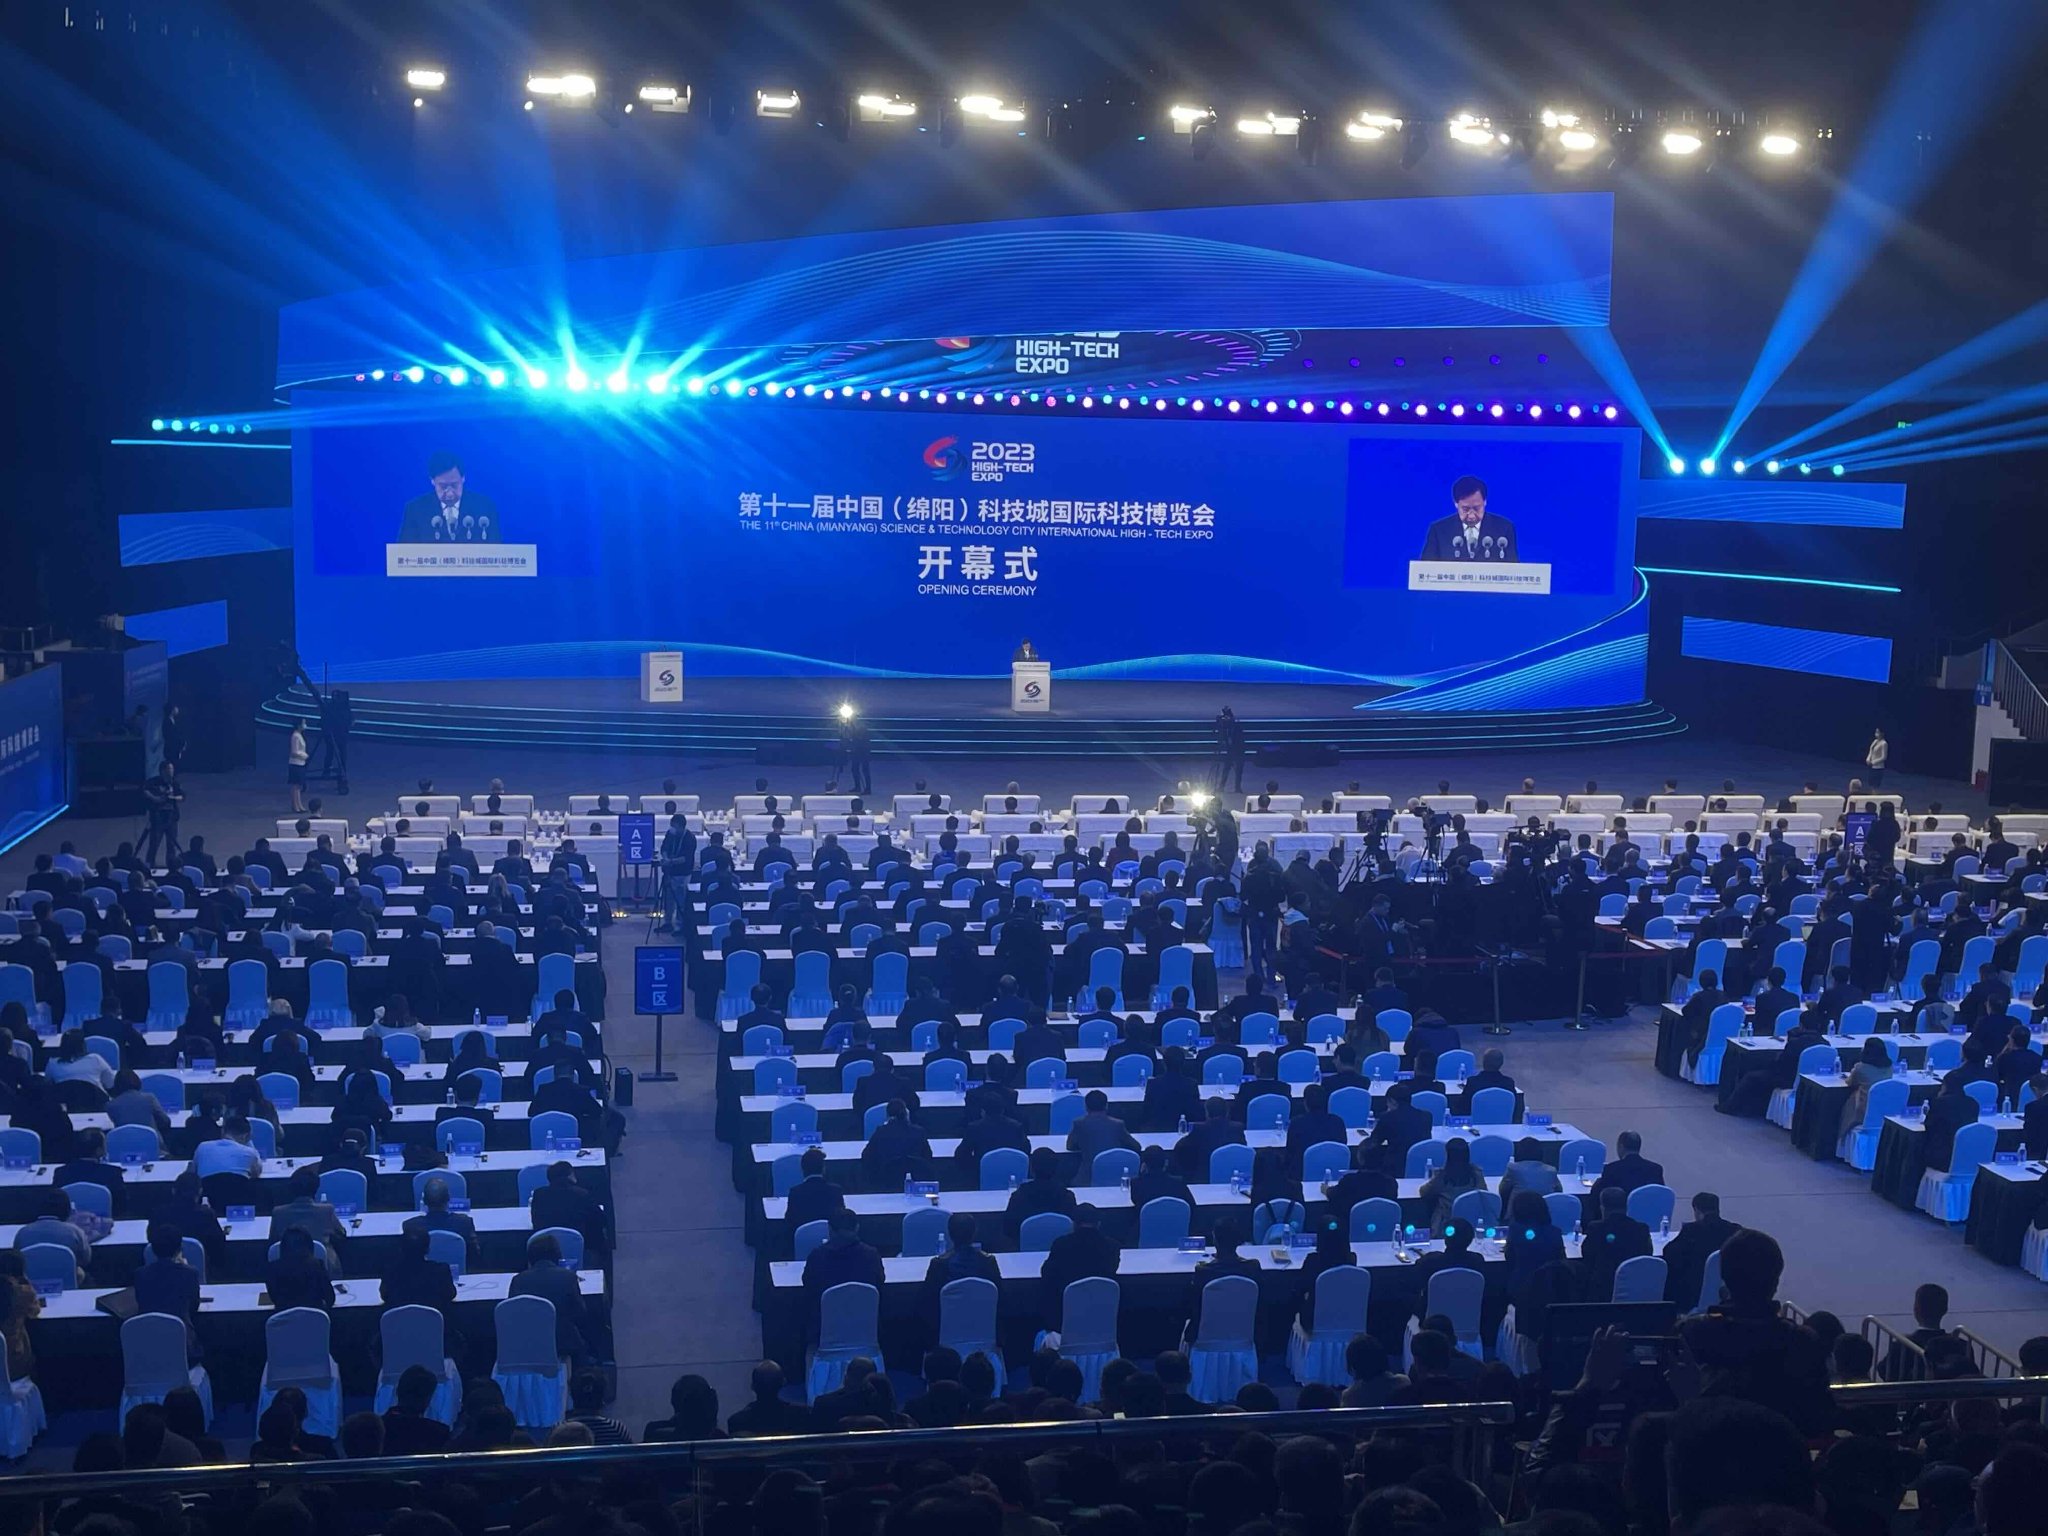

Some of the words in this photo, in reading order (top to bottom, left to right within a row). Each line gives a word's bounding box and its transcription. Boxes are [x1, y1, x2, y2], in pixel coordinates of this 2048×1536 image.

[1015, 340, 1119, 358] HIGH-TECH
[1015, 357, 1070, 375] EXPO
[971, 442, 1036, 461] 2023
[971, 462, 1034, 473] HIGH-TECH
[971, 472, 1004, 482] EXPO
[740, 519, 761, 530] THE
[781, 520, 815, 532] CHINA
[816, 521, 878, 535] (MIANYANG)
[880, 523, 926, 535] SCIENCE
[928, 524, 936, 535] &
[938, 524, 1010, 537] TECHNOLOGY
[1011, 525, 1035, 536] CITY
[1037, 526, 1119, 539] INTERNATIONAL
[1154, 529, 1182, 540] TECH
[1184, 530, 1214, 541] EXPO
[918, 544, 1038, 582] 开幕式
[917, 584, 970, 596] OPENING
[972, 584, 1038, 597] CEREMONY
[631, 829, 641, 840] A
[1856, 826, 1865, 835] A
[631, 847, 642, 858] 区
[654, 967, 665, 980] B
[653, 991, 667, 1005] 区
